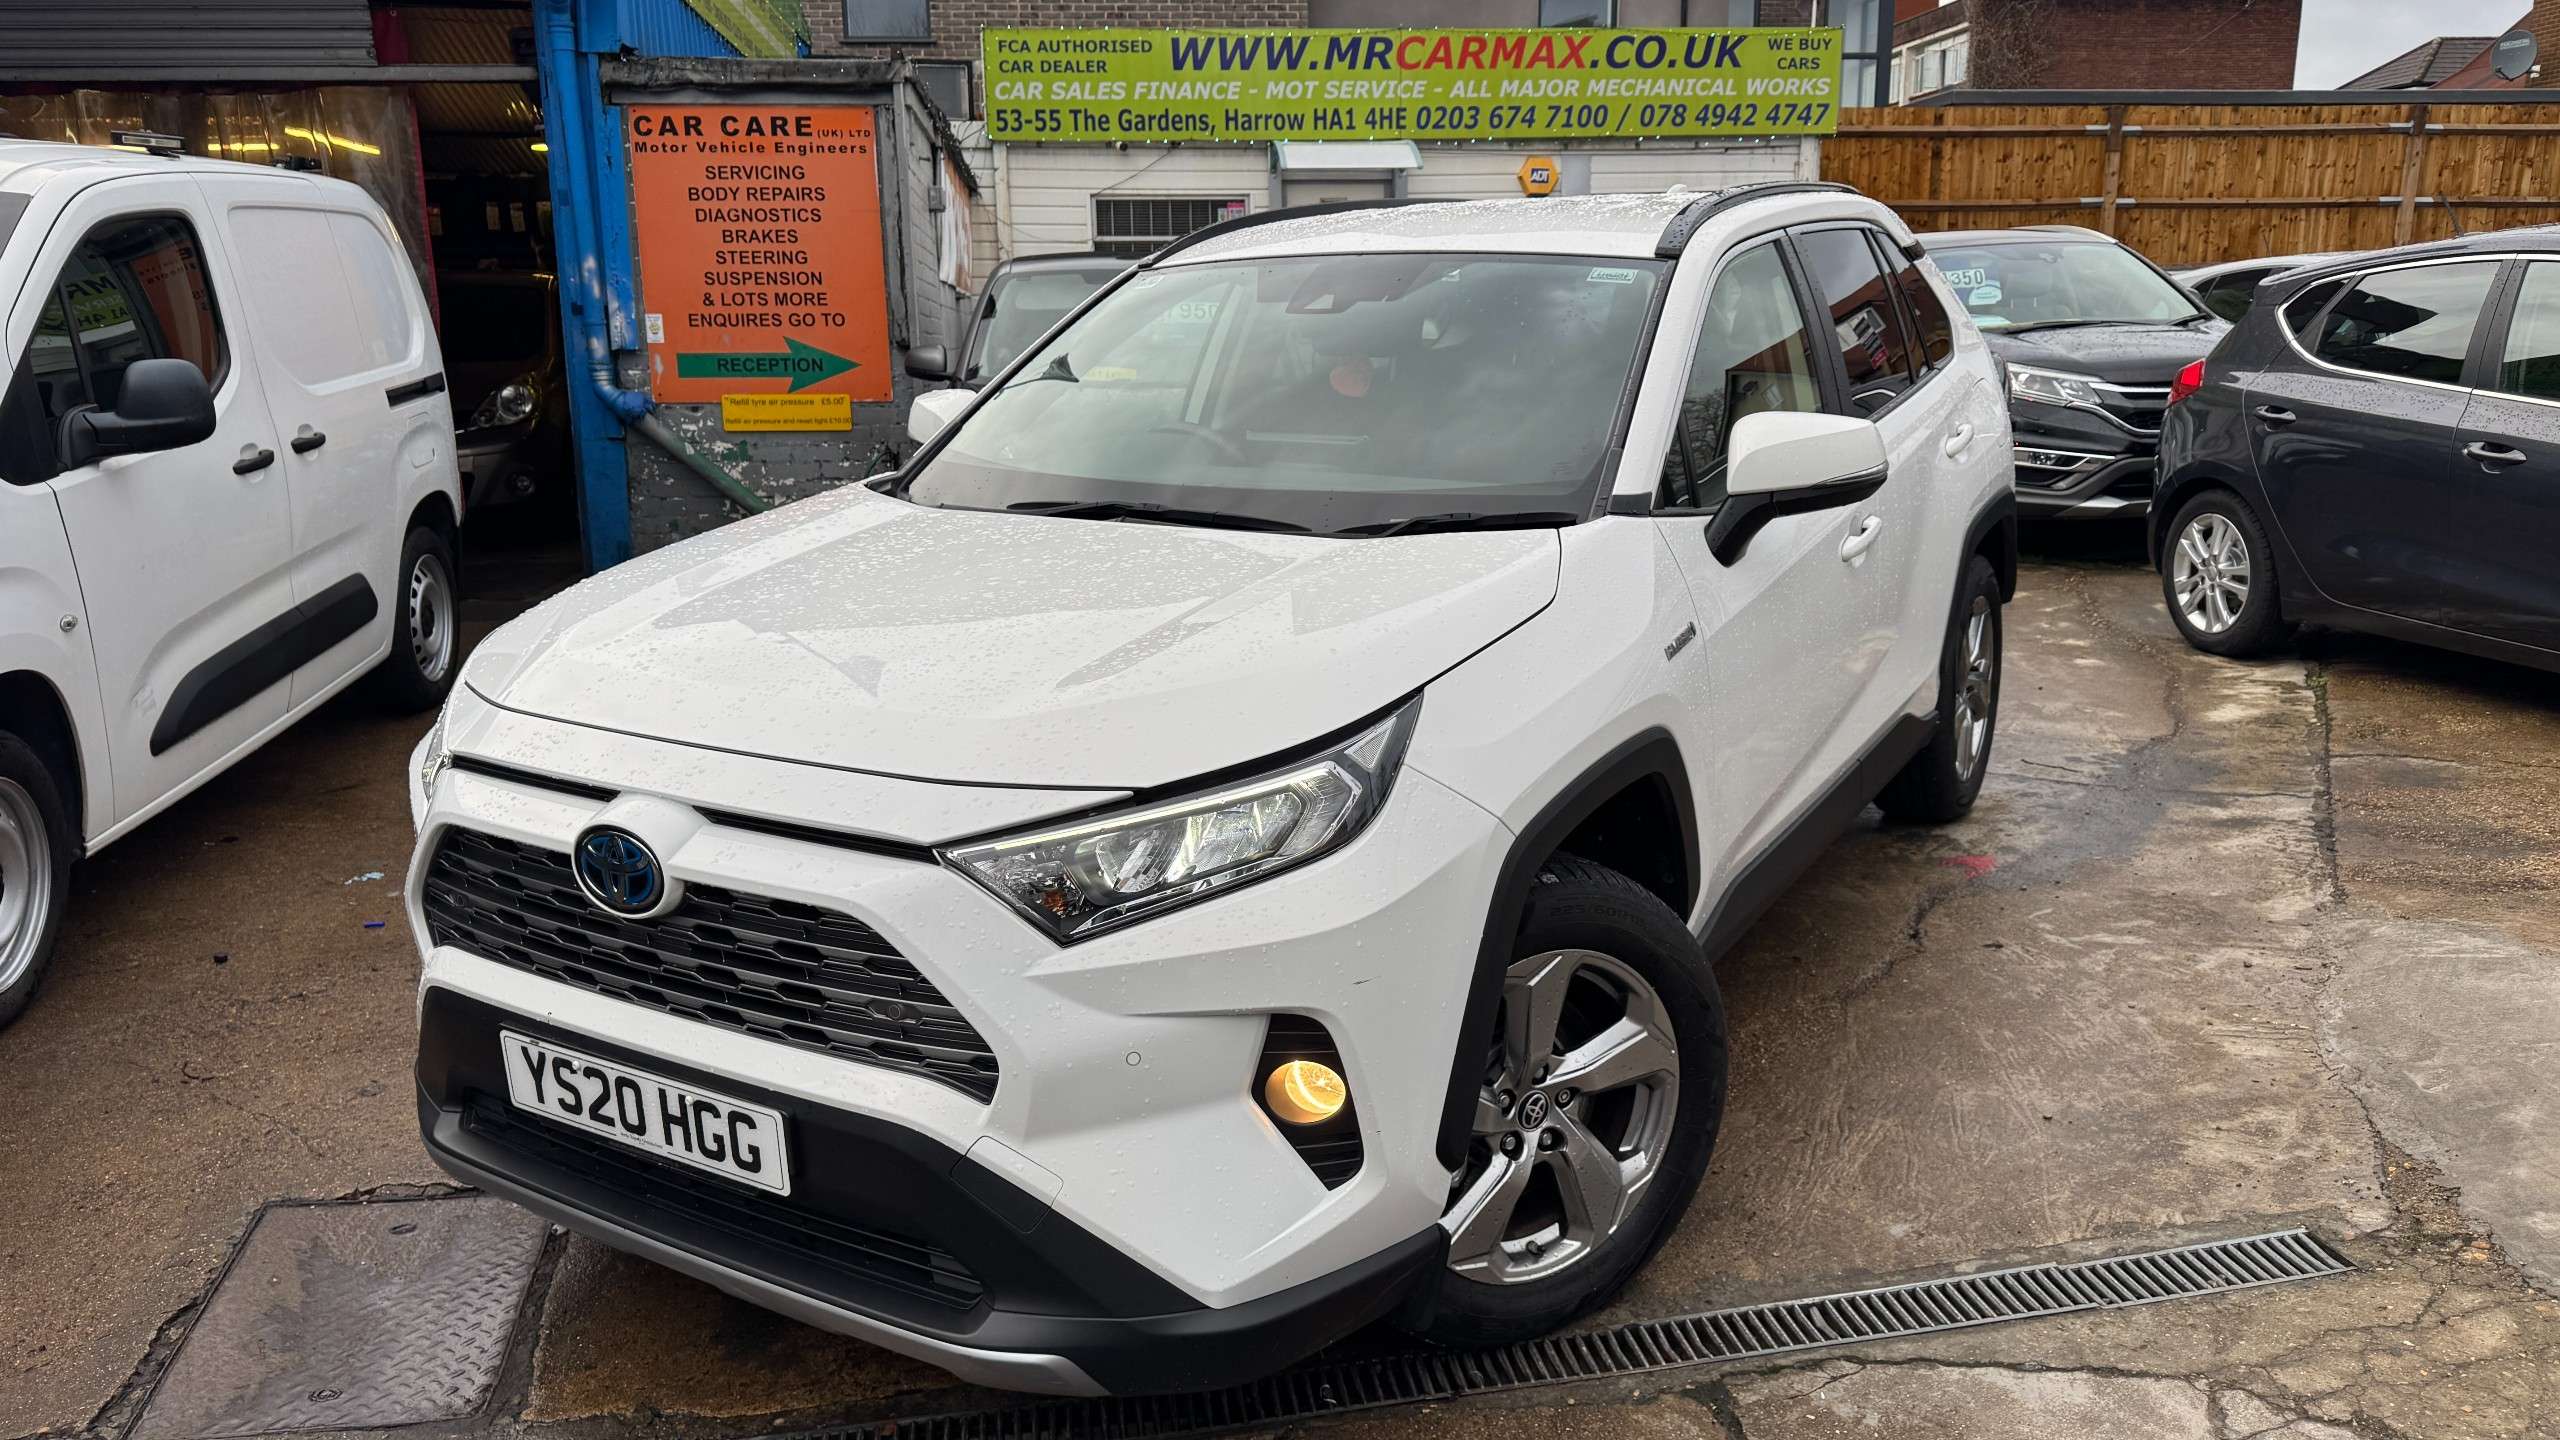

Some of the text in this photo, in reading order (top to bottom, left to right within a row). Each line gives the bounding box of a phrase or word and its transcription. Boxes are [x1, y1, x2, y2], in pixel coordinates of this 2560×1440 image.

[998, 39, 1153, 53] FCA AUTHORISED
[1768, 38, 1832, 51] WE BUY
[1171, 34, 1748, 71] WWW.MRCARMAX.CO.UK
[999, 60, 1108, 73] CAR DEALER
[1777, 57, 1821, 70] CARS
[994, 81, 1043, 101] CAR
[1050, 81, 1128, 100] SALES
[1133, 81, 1242, 100] FINANCE
[1265, 80, 1318, 99] MOT
[1324, 80, 1427, 99] SERVICE
[1450, 79, 1492, 98] ALL
[1499, 79, 1580, 98] MAJOR
[1587, 78, 1738, 97] MECHANICAL
[1747, 77, 1831, 96] WORKS
[633, 115, 871, 138] CAR CARE (UK) LTD
[995, 108, 1061, 132] 53-55
[1068, 108, 1110, 132] The
[1118, 108, 1216, 136] Gardens,
[1225, 108, 1304, 132] Harrow
[1313, 107, 1356, 131] HA1
[1365, 107, 1407, 130] 4HE
[1416, 105, 1480, 130] 0203
[1489, 105, 1536, 129] 674
[1546, 104, 1608, 129] 7100
[1640, 103, 1687, 128] 078
[1695, 103, 1758, 128] 4942
[1765, 102, 1830, 127] 4747
[634, 141, 868, 156] Motor Vehicle Engineers
[705, 165, 805, 180] SERVICING
[1531, 169, 1549, 182] ADT
[688, 186, 826, 201] BODY REPAIRS
[695, 208, 822, 223] DIAGNOSTICS
[722, 229, 798, 243] BRAKES
[715, 250, 808, 265] STEERING
[704, 271, 823, 286] SUSPENSION
[703, 292, 828, 306] & LOTS MORE
[688, 313, 846, 328] ENQUIRES GO TO
[717, 358, 824, 373] RECEPTION
[781, 399, 815, 407] pressure
[521, 1046, 762, 1173] YS20 HGG
